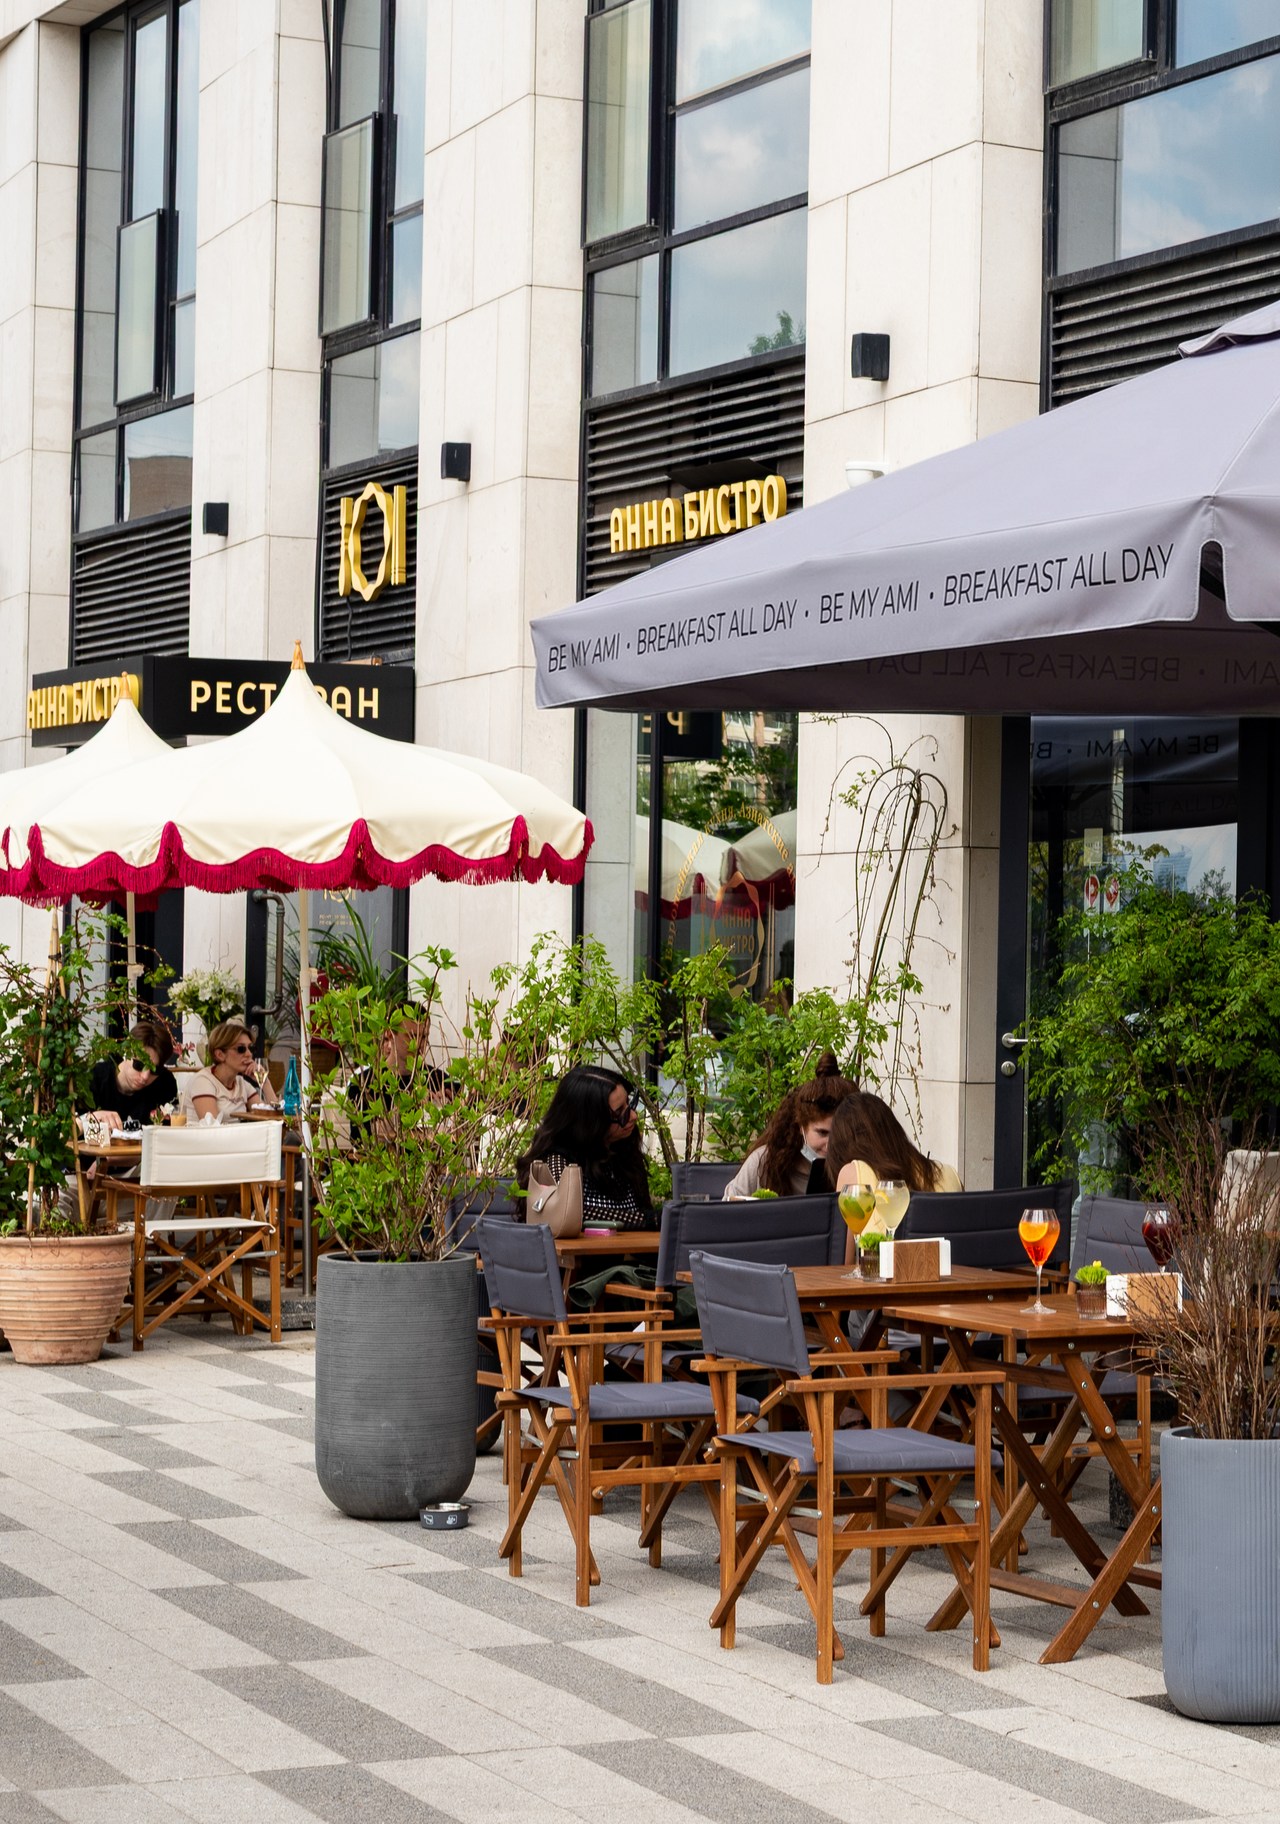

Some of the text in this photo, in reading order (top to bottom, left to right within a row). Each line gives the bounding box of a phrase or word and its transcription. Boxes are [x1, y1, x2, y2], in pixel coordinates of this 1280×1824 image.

[610, 474, 787, 553] АННА БИСТРО
[549, 543, 1174, 673] BE MY AMI BREAKFAST ALL DAY BE MY AMI BREAKFAST ALL DAY
[27, 674, 139, 729] АННА БИСТР
[739, 802, 789, 862] Азиатские
